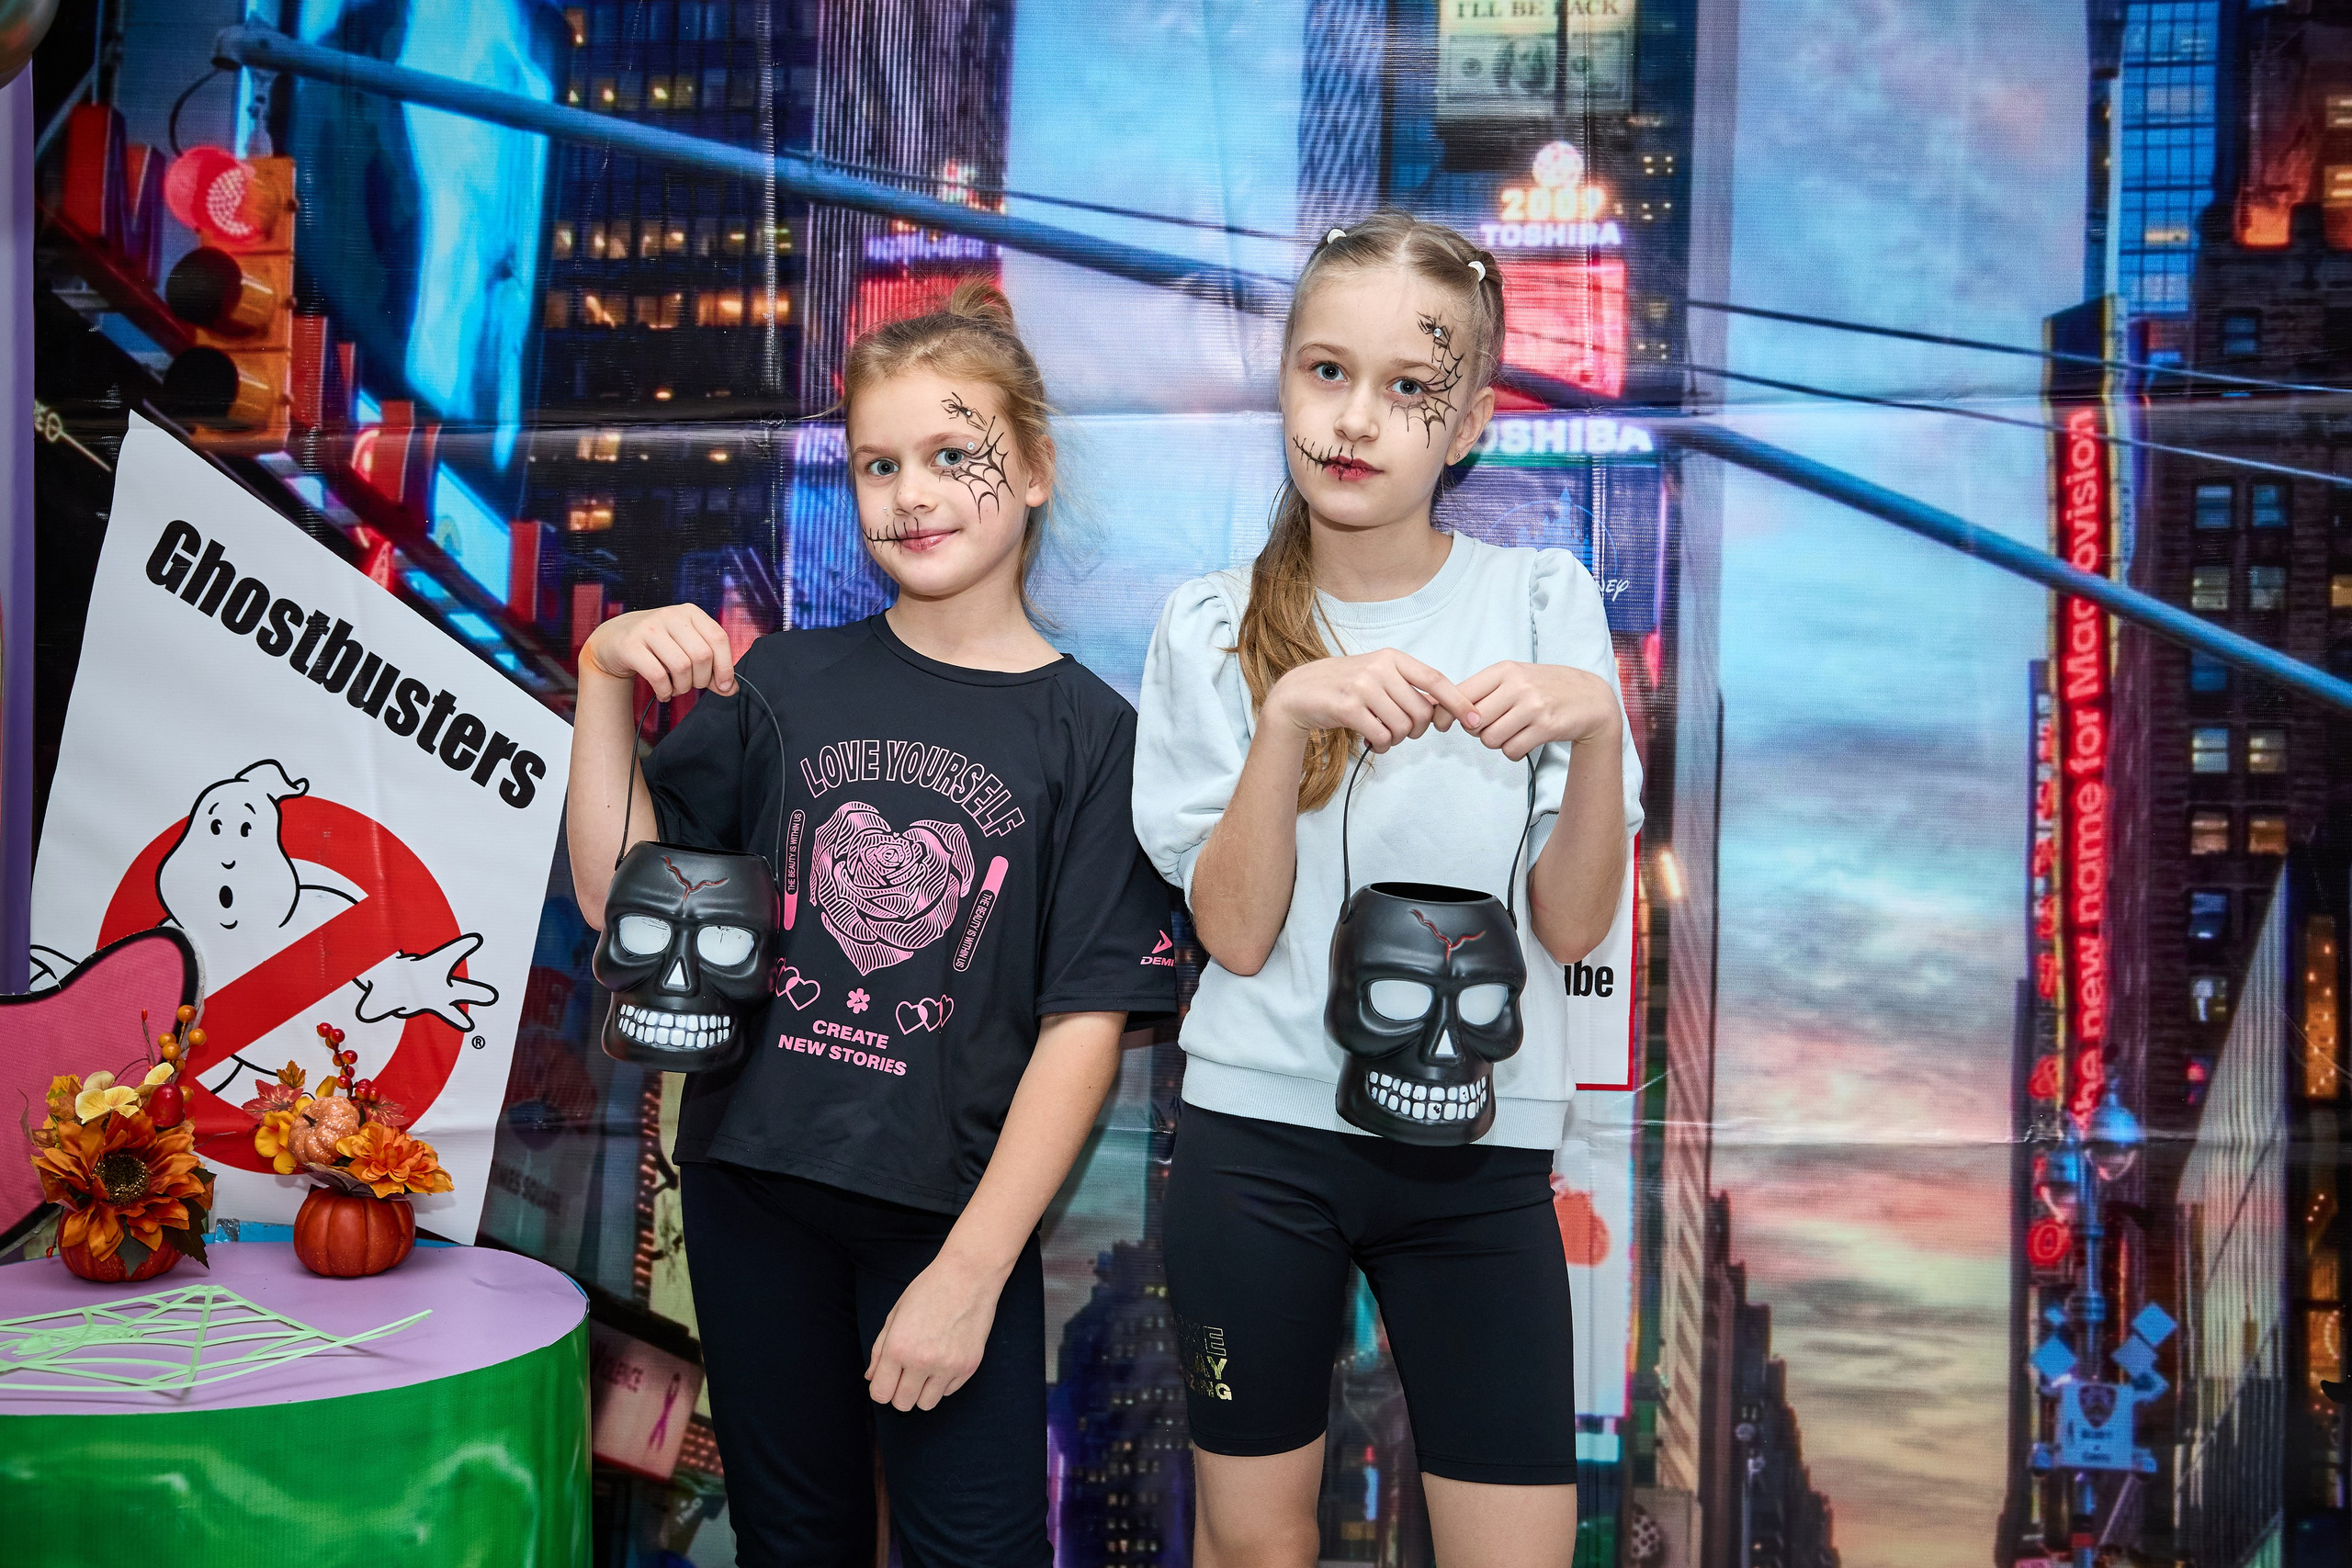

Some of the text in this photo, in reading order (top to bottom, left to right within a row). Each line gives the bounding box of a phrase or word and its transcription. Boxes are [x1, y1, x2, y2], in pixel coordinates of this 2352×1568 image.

[1512, 0, 1544, 17] BE
[1560, 0, 1620, 17] ACK
[1480, 222, 1622, 246] TOSHIBA
[2065, 409, 2099, 700] Macovision
[145, 519, 547, 809] Ghostbusters
[2067, 708, 2102, 775] for
[800, 739, 1026, 838] LOVE YOURSELF
[790, 823, 800, 845] WITHIN
[794, 813, 802, 822] US
[788, 852, 797, 878] BEAUTY
[2076, 780, 2105, 923] name
[787, 879, 796, 891] THE
[956, 893, 993, 968] THE BEAUTY IS WITHIN US
[2079, 936, 2106, 1039] new
[778, 1034, 908, 1076] NEW STORIES
[812, 1020, 889, 1050] CREATE
